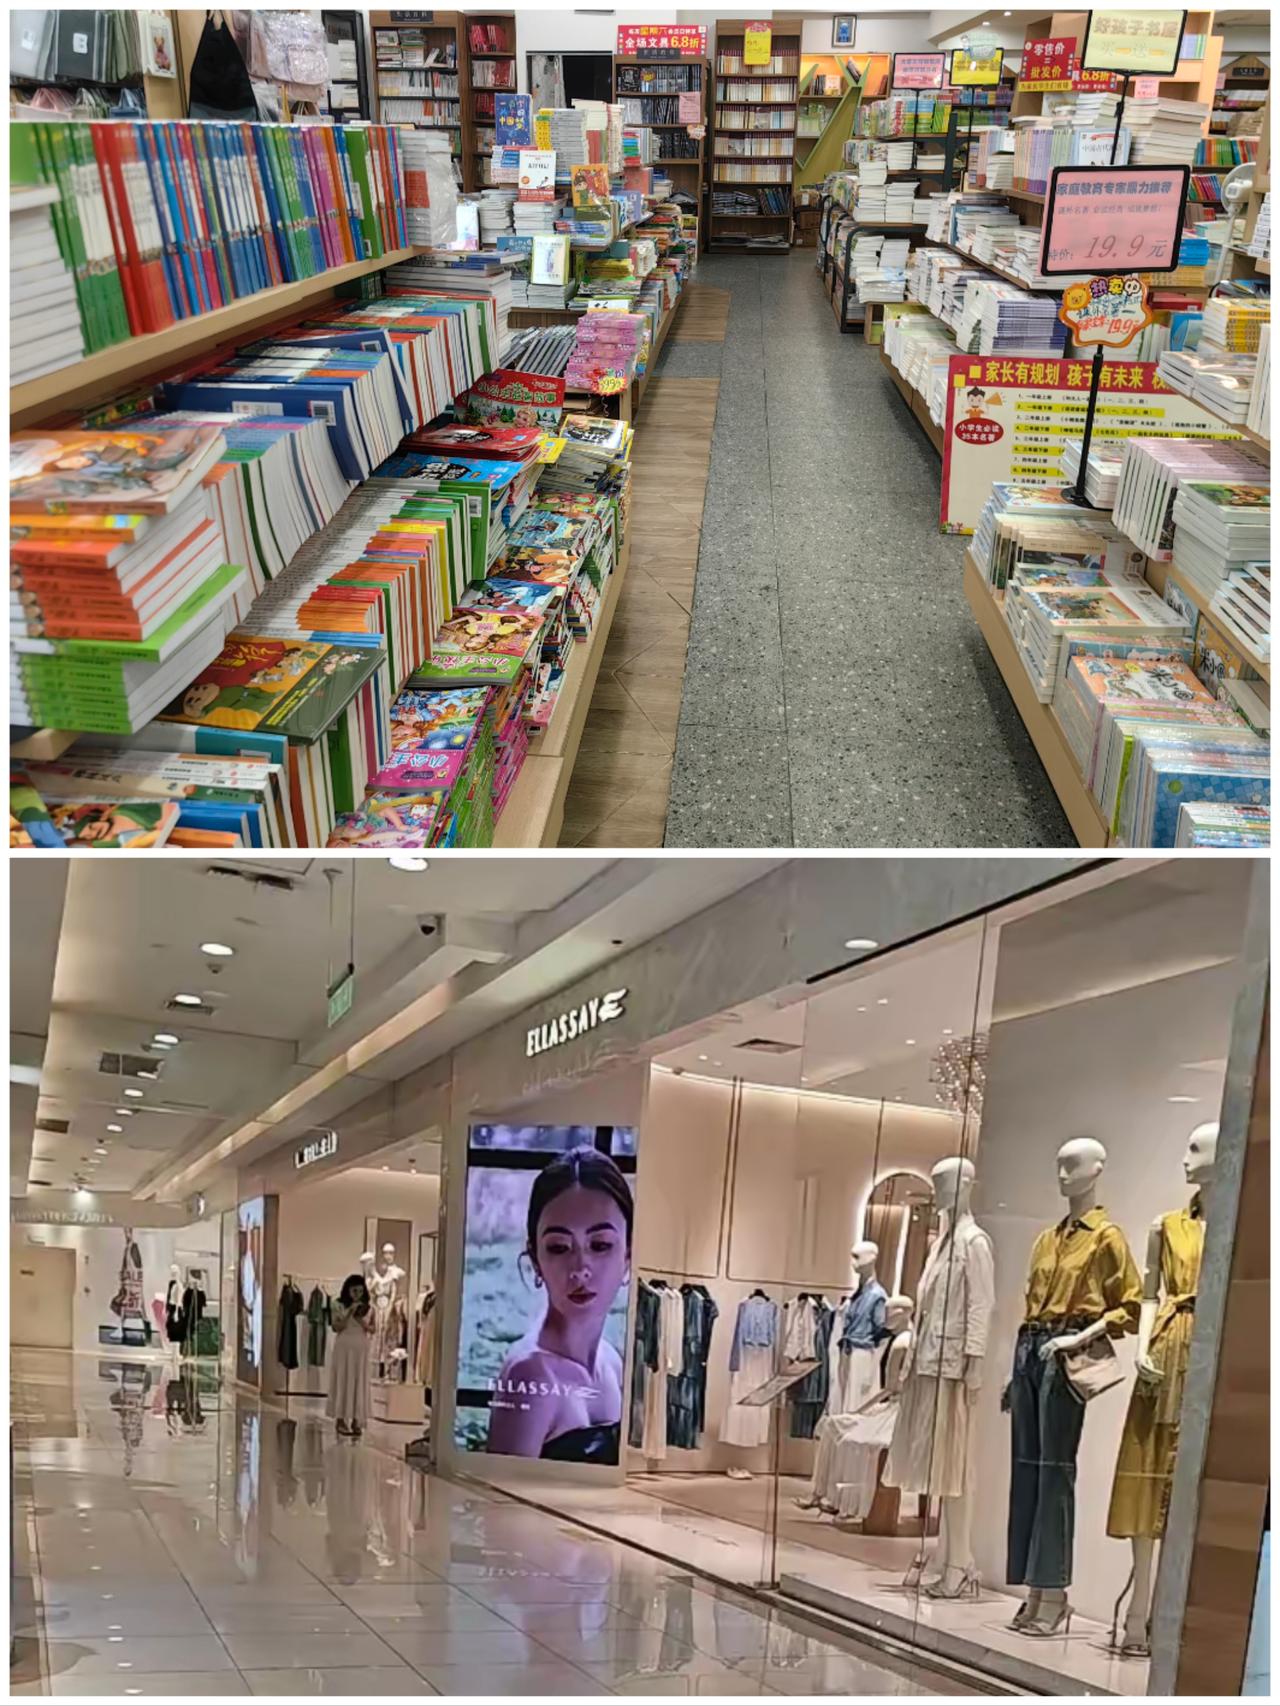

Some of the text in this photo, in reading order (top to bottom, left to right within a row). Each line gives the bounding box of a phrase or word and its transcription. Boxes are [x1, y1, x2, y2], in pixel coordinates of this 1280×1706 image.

[1034, 42, 1065, 56] 零售价
[1031, 65, 1062, 79] 批发价
[1084, 234, 1145, 259] 19.9
[1147, 240, 1168, 258] 元
[985, 361, 1060, 386] 家长有规划
[1067, 364, 1144, 389] 孩子有未来
[959, 423, 1000, 433] 小学生必读
[962, 432, 996, 441] 35本名著
[525, 997, 599, 1056] ELLASSAY
[487, 1378, 573, 1397] ELLASSAY
